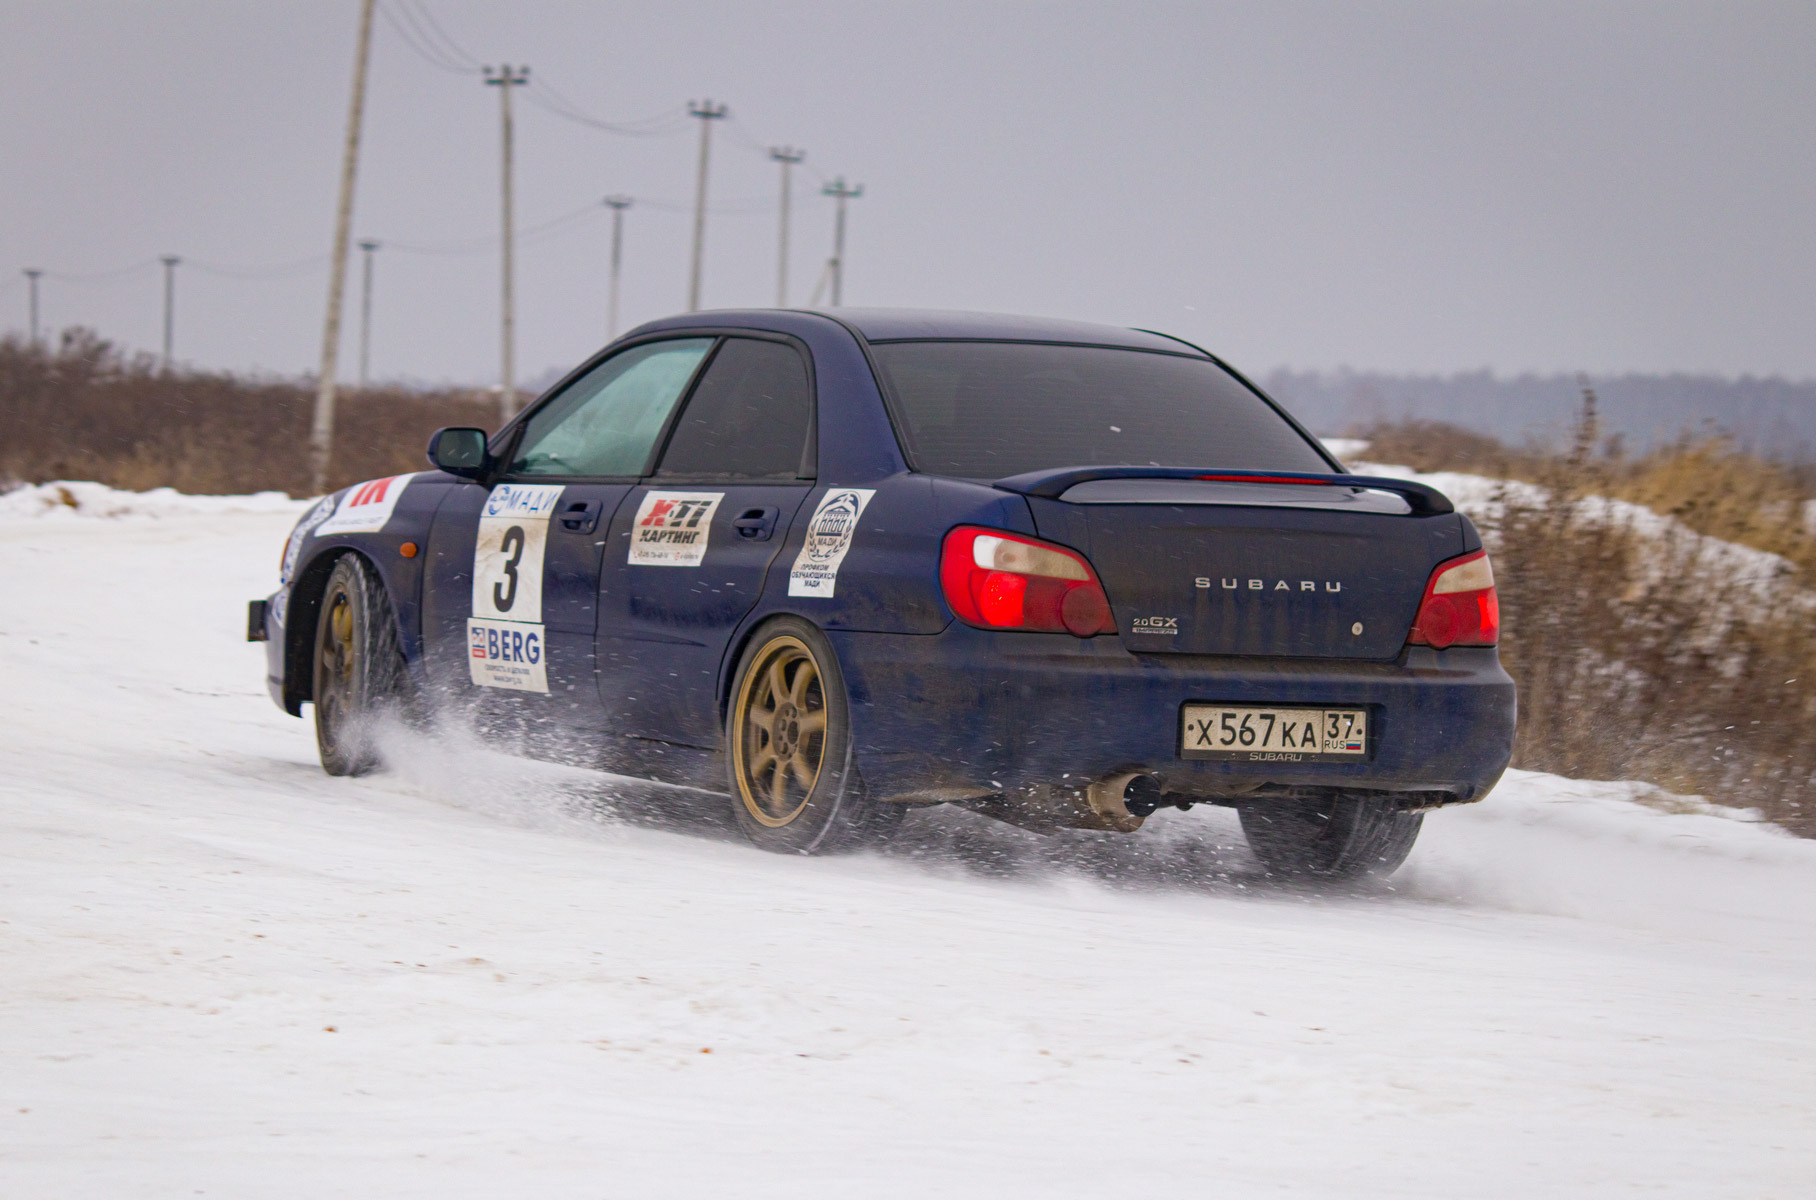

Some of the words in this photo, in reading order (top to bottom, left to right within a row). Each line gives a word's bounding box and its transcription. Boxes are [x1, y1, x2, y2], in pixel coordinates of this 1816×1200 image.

[506, 490, 558, 513] МАДИ
[640, 529, 700, 544] КАРТИНГ
[817, 537, 837, 546] МАДИ
[494, 525, 524, 612] 3
[801, 563, 830, 571] ПРОФКОМ
[791, 571, 835, 580] ОБУЧАЮЩИХСЯ
[804, 580, 820, 588] МАДИ
[1194, 577, 1341, 592] SUBARU
[488, 628, 540, 664] BERG
[1327, 713, 1356, 740] 37
[1324, 740, 1345, 750] RUS
[1249, 752, 1302, 761] SUBARU
